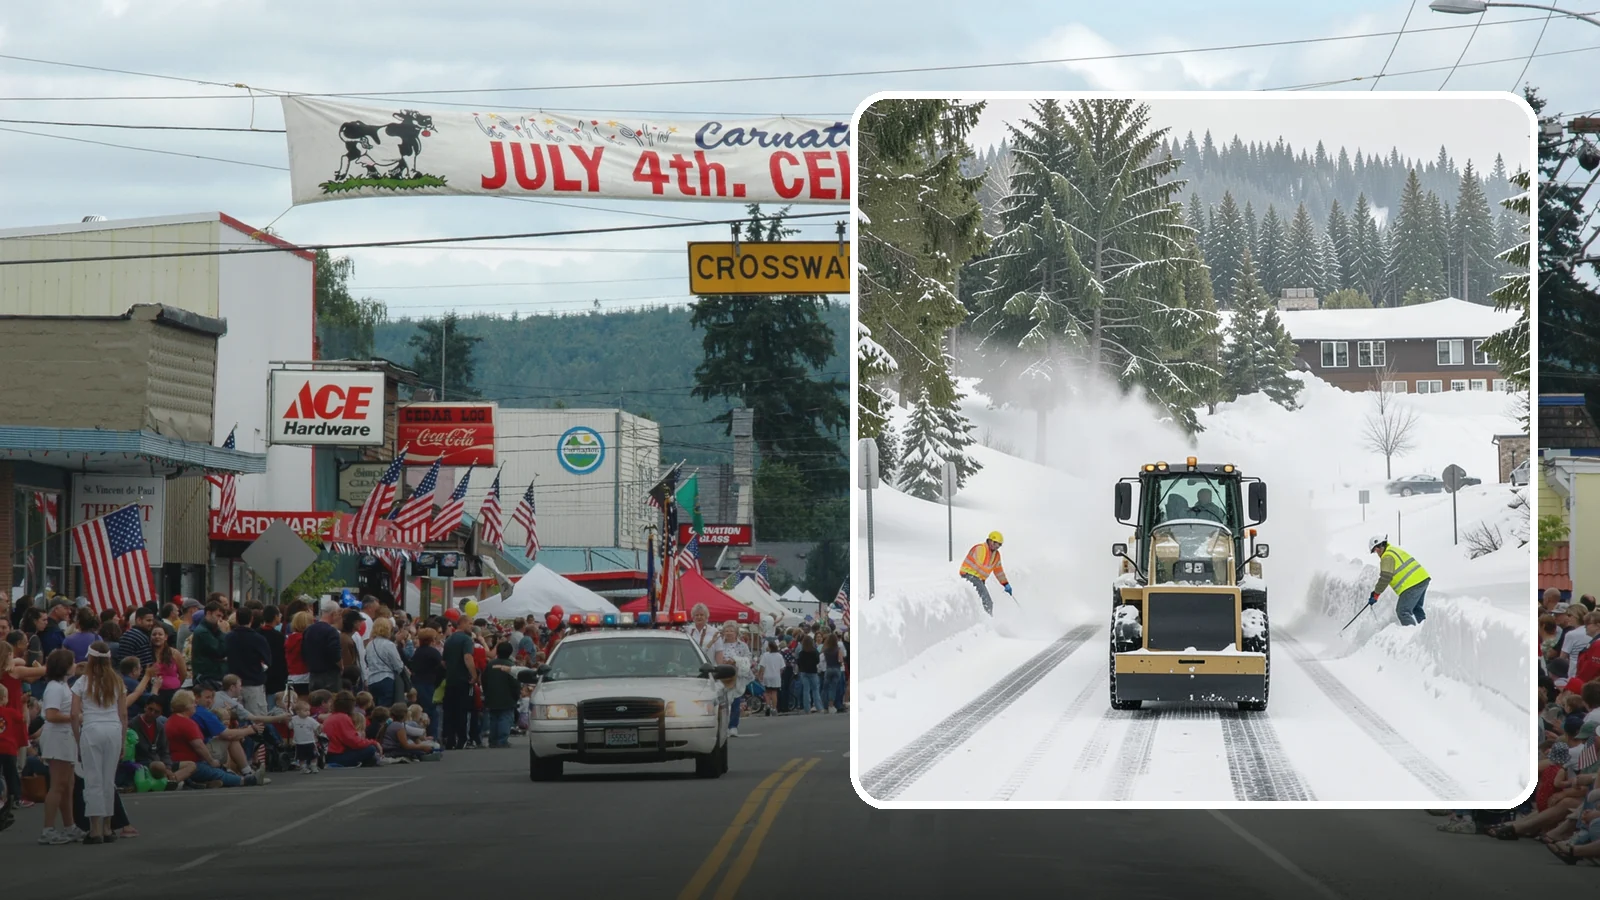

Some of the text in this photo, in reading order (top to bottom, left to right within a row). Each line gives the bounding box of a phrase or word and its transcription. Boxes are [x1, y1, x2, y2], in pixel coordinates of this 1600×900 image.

[695, 121, 850, 150] Carnat
[481, 141, 605, 192] JULY
[632, 150, 746, 198] 4th.
[697, 254, 850, 280] CROSSWA
[283, 380, 373, 420] ACE
[405, 408, 452, 422] CEDAR
[283, 421, 370, 437] Hardware
[416, 428, 477, 447] Coca-Cola
[353, 466, 384, 479] Simpl
[96, 485, 124, 495] Vincent
[126, 486, 135, 495] de
[138, 486, 155, 495] Paul
[688, 526, 741, 535] CRNATION
[699, 535, 730, 543] GLASS
